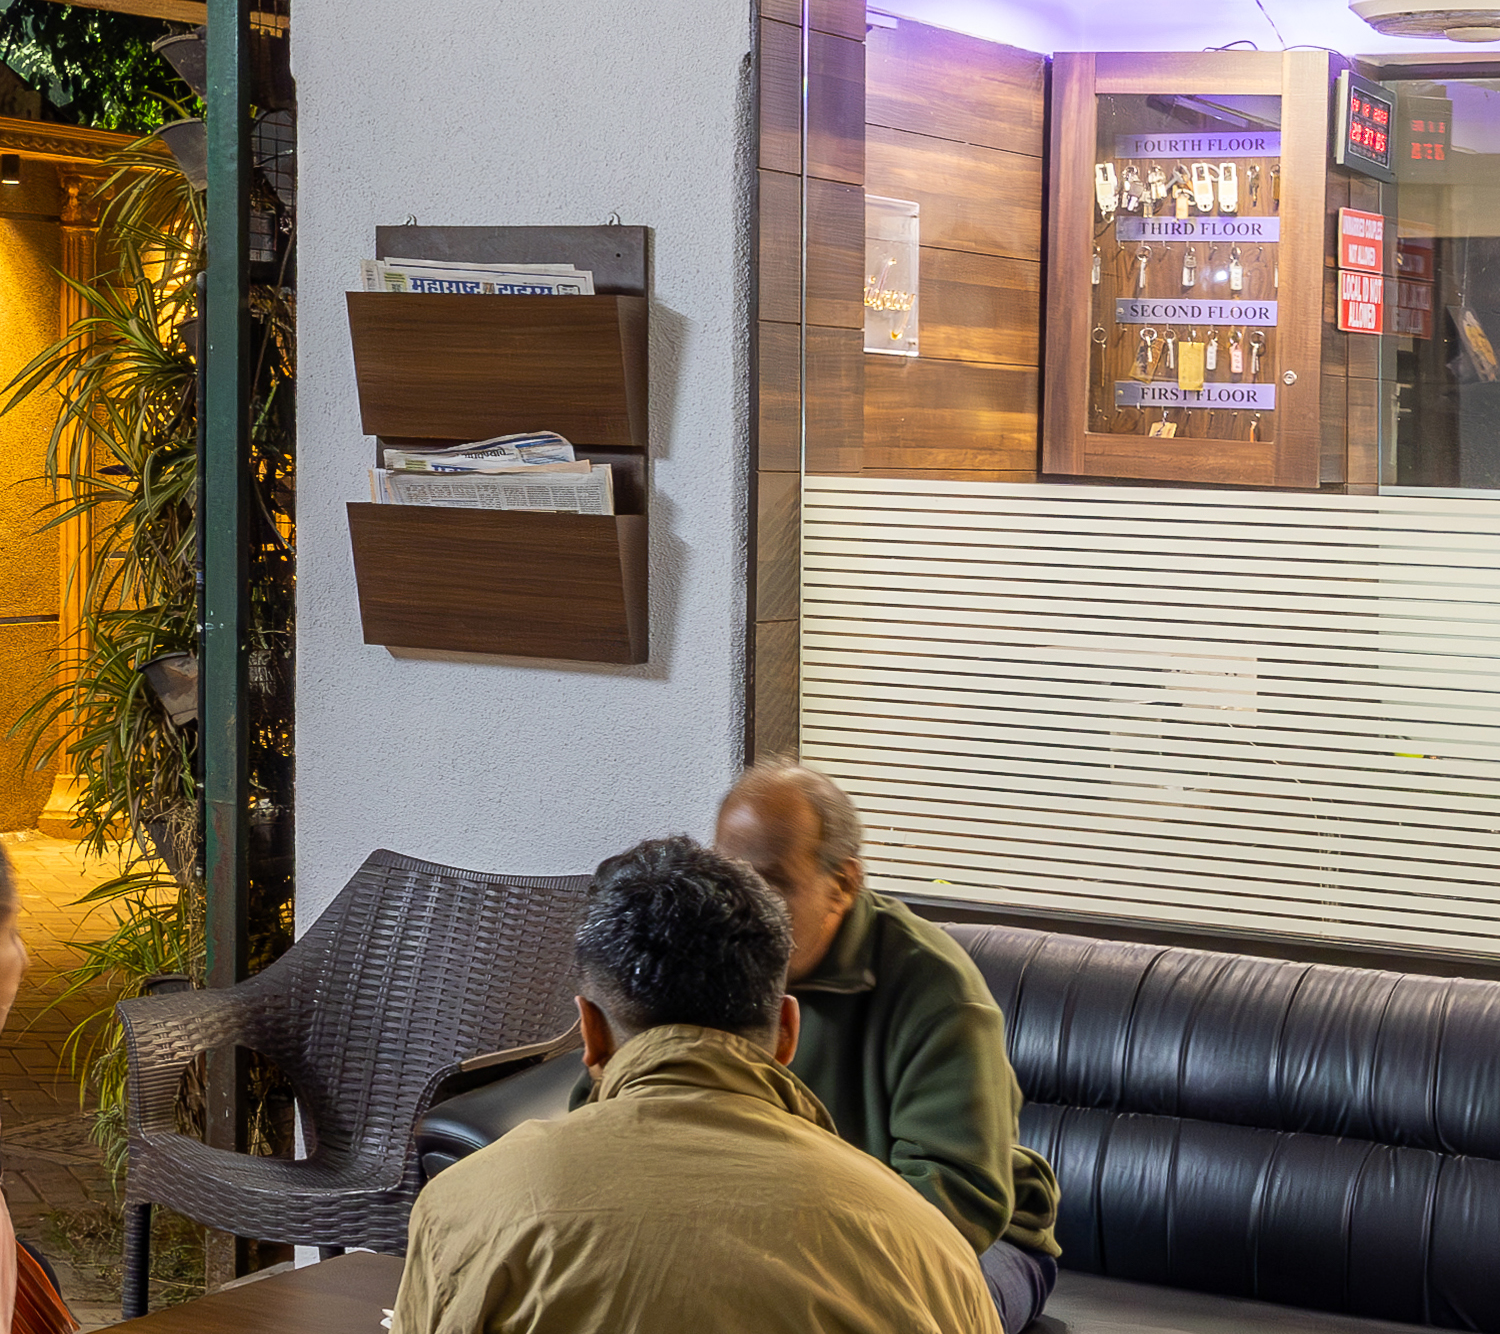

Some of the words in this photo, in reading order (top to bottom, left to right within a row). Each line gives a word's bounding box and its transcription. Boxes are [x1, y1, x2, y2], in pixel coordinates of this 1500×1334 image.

[1135, 139, 1202, 153] FOURTH
[1208, 138, 1266, 152] FLOOR
[1141, 222, 1195, 236] THIRD
[1201, 222, 1263, 236] FLOOR
[1348, 244, 1358, 264] NOT
[1358, 245, 1376, 267] ALLOWED
[1342, 273, 1362, 302] LOCAL
[1362, 277, 1369, 303] ID
[1370, 278, 1383, 304] NOT
[1130, 304, 1203, 319] SECOND
[1207, 306, 1270, 320] FLOOR
[1348, 301, 1376, 329] ALLOWED
[1140, 387, 1188, 401] FIRST
[1196, 389, 1258, 403] FLOOR
